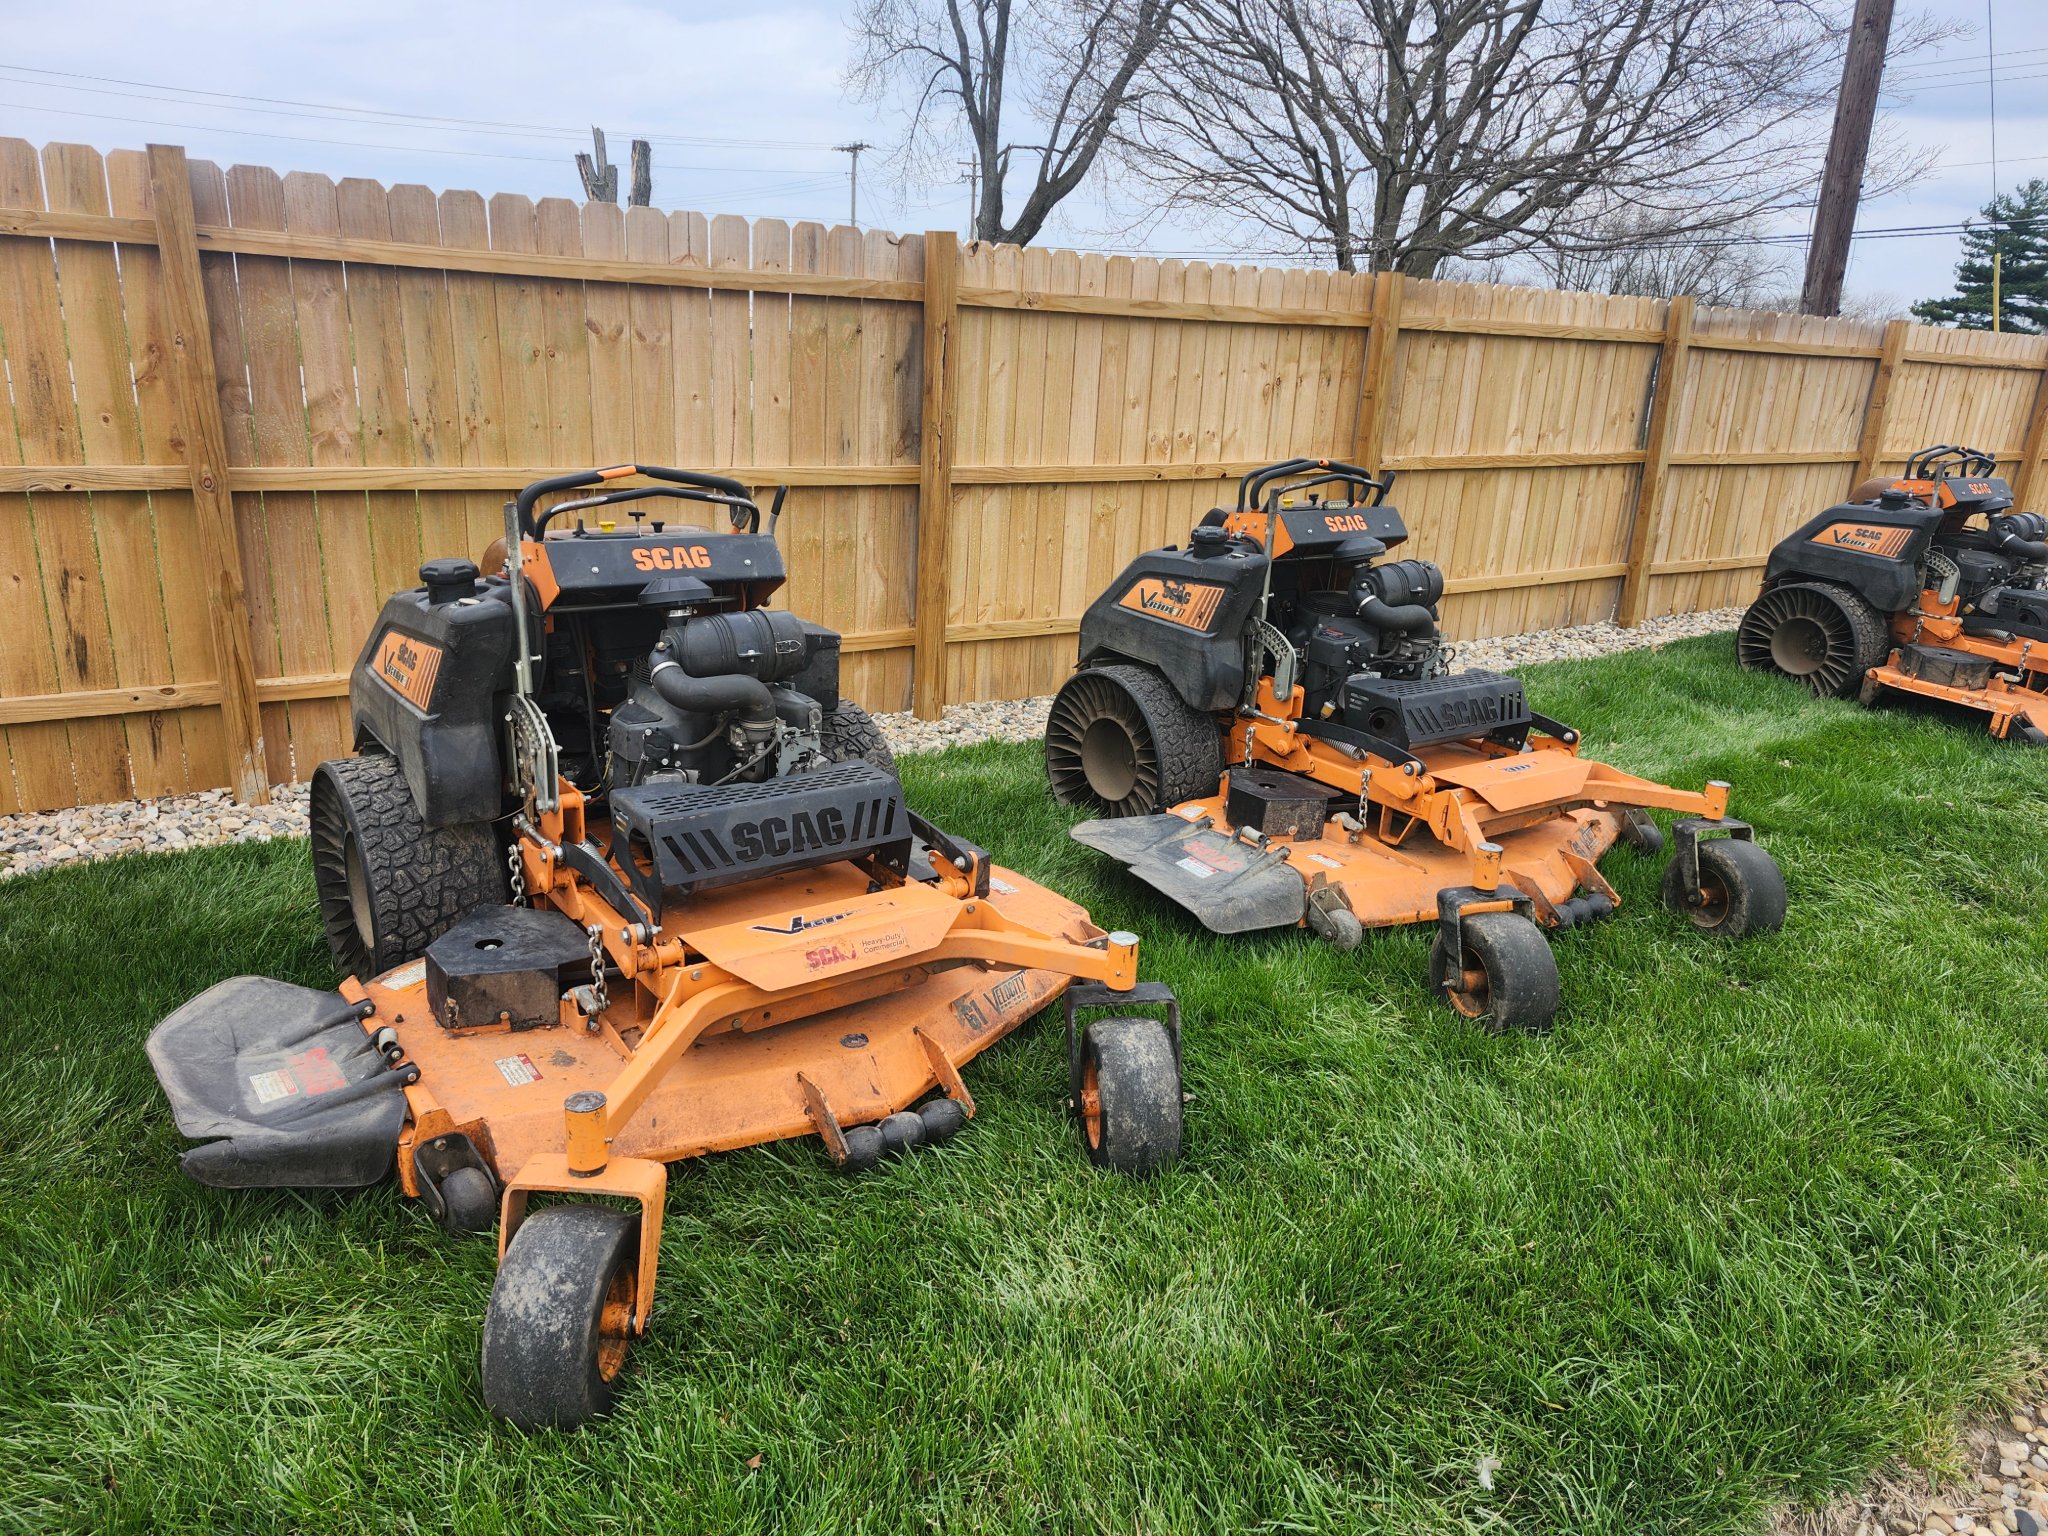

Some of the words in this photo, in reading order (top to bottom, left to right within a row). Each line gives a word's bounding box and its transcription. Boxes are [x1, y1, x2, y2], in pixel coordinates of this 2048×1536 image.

[1968, 483, 1992, 495] SCAG
[1324, 514, 1368, 532] SCAG
[1855, 528, 1882, 540] SCAG
[631, 545, 712, 571] SCAG
[1440, 696, 1499, 731] SCAG
[731, 806, 847, 863] SCAG
[862, 933, 901, 947] Heavy-Duty
[863, 939, 905, 954] Commercial
